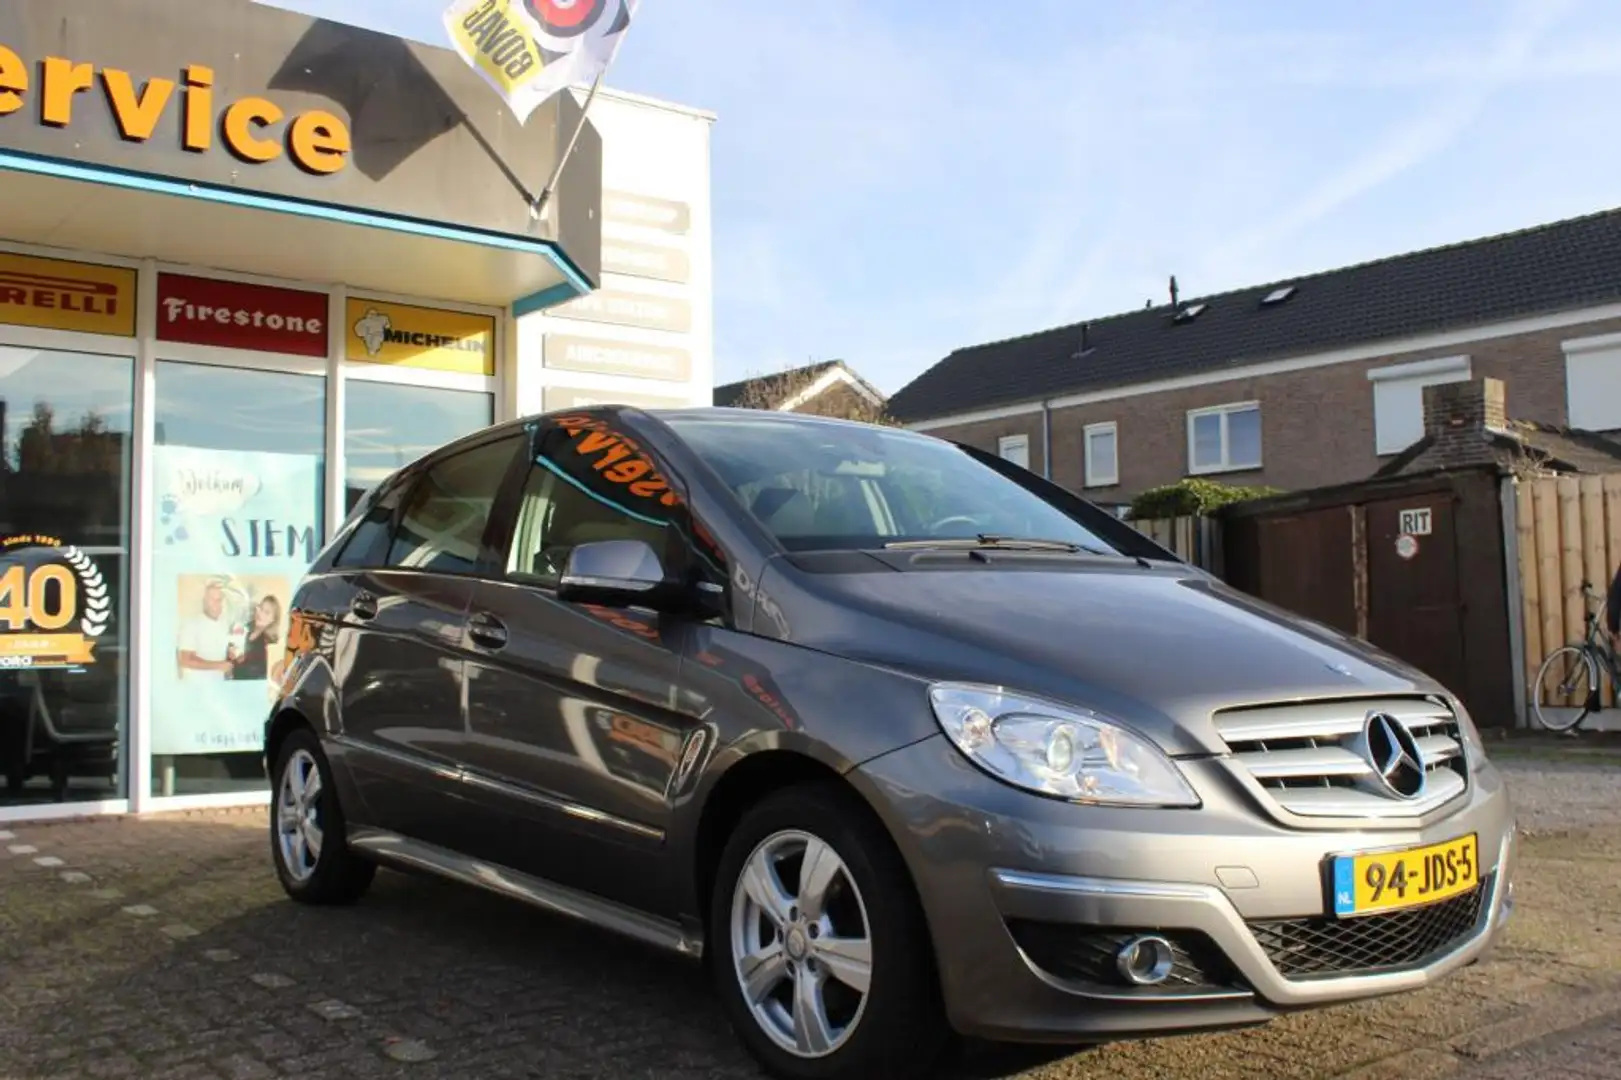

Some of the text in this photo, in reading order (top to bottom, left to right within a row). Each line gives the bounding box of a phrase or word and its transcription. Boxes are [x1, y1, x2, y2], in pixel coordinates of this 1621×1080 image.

[0, 282, 117, 317] RELLI
[162, 296, 324, 334] Firestone
[383, 326, 487, 355] MICHELIN
[1402, 511, 1430, 533] RIT
[0, 563, 76, 629] 40
[1337, 843, 1473, 905] NL 94-JDS-5
